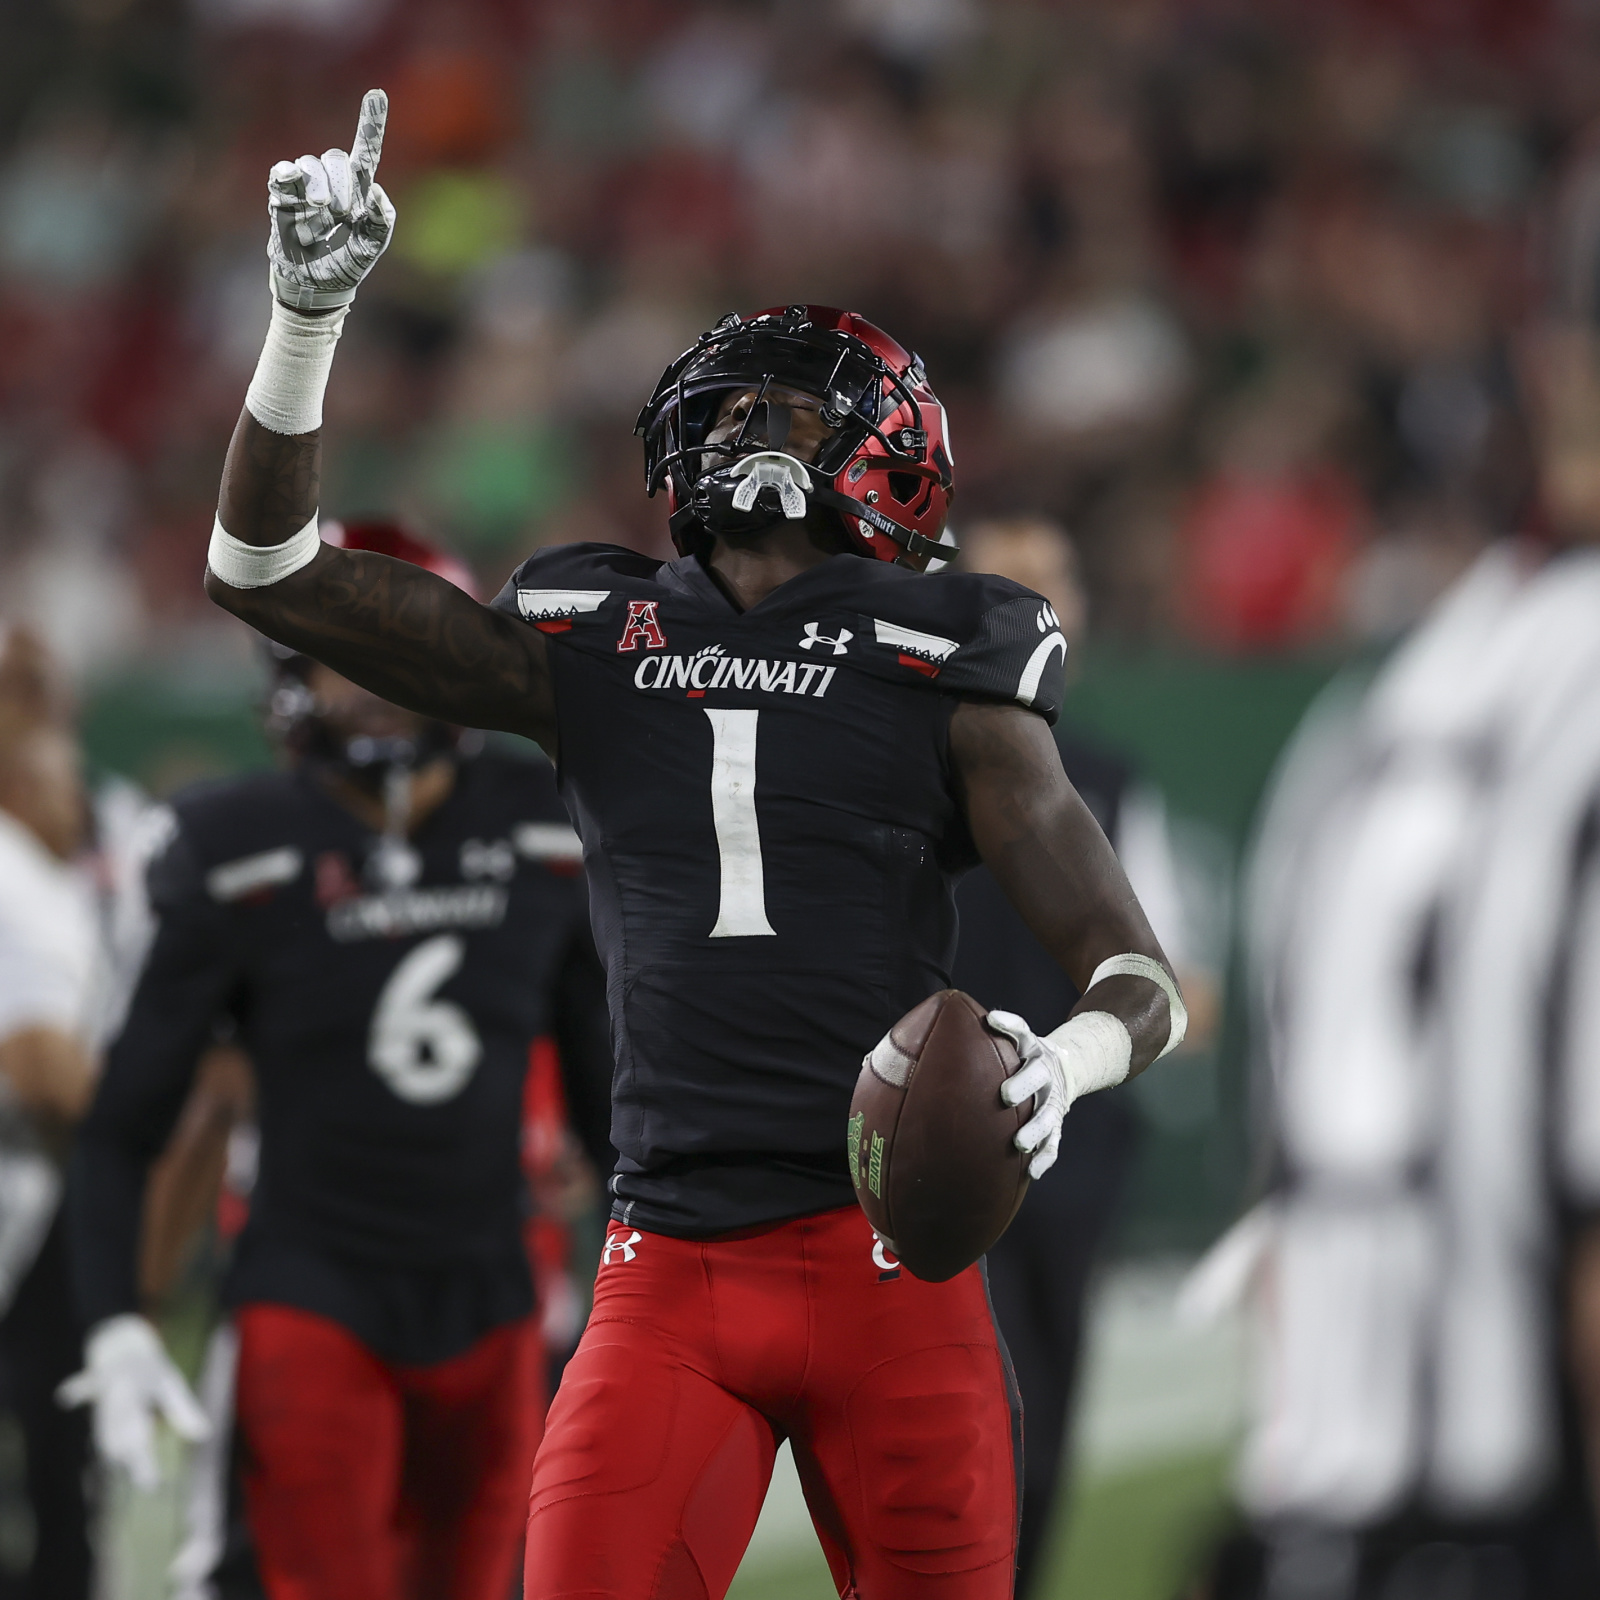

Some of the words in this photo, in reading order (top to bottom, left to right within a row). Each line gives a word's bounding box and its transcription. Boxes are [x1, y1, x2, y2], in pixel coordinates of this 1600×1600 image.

[634, 652, 836, 697] CINCINNATI
[703, 708, 777, 938] 1
[368, 934, 482, 1103] 6
